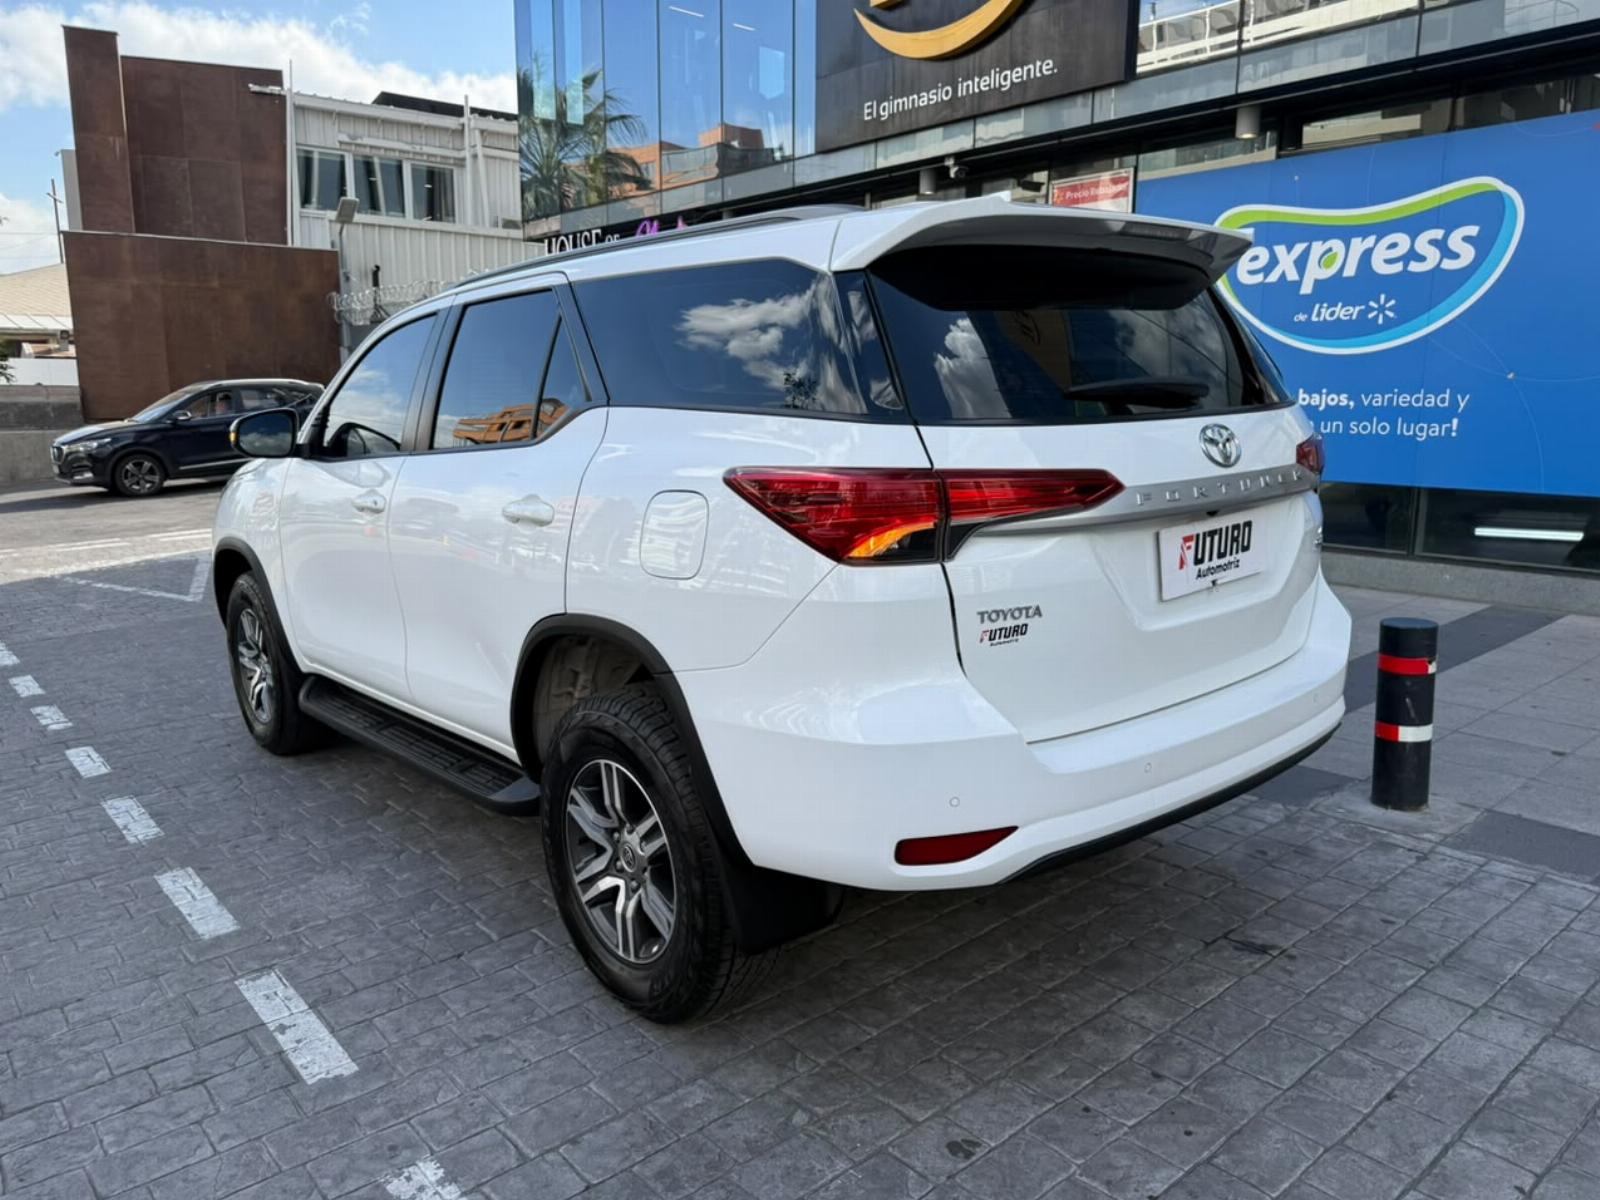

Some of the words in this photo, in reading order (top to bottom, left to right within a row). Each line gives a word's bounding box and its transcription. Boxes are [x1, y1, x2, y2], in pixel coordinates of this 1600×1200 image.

[863, 102, 877, 121] El
[879, 83, 952, 121] gimnasio
[957, 59, 1058, 98] inteligente.
[1236, 224, 1481, 295] express
[1294, 312, 1308, 323] de
[1298, 388, 1355, 411] bajos,
[1360, 389, 1451, 408] variedad
[1457, 393, 1470, 413] y
[1320, 421, 1343, 434] un
[1349, 416, 1390, 435] solo
[1396, 417, 1459, 441] lugar!
[1178, 520, 1253, 570] FUTURO
[1195, 556, 1240, 580] Automotriz
[976, 604, 1042, 624] TOYOTA
[979, 623, 1028, 643] FUTURO
